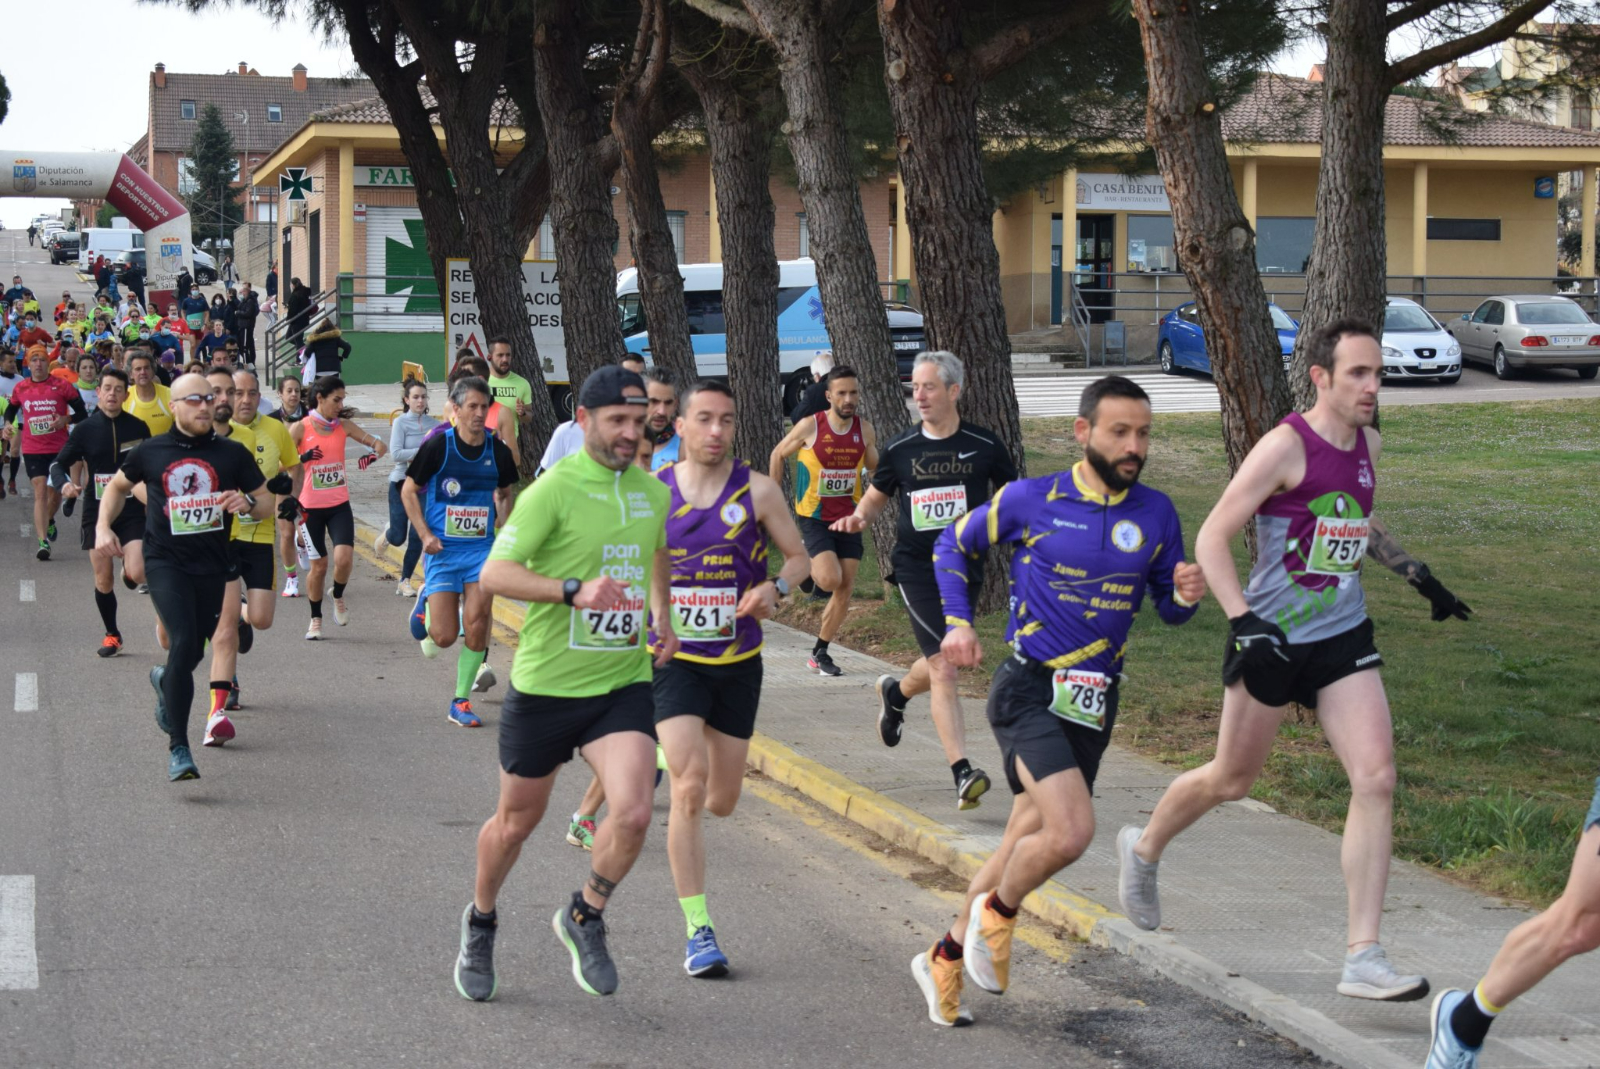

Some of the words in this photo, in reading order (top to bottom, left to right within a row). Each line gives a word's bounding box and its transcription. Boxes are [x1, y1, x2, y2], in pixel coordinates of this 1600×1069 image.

[38, 166, 84, 176] Diputación
[49, 178, 93, 187] Salamanca
[1093, 183, 1126, 194] CASA
[1128, 184, 1165, 195] BENIT
[116, 181, 160, 221] DEPORTISTAS
[120, 172, 136, 188] CON
[134, 185, 169, 217] NUESTROS
[496, 387, 516, 397] RUN
[34, 422, 50, 431] 780
[312, 462, 343, 475] bedunia
[821, 470, 857, 480] bedunia
[910, 456, 974, 477] Kaoba
[319, 471, 340, 484] 769
[826, 479, 849, 491] 801
[913, 489, 965, 506] bedunia
[181, 507, 213, 525] 797
[448, 507, 488, 519] bedunia
[922, 501, 956, 520] 707
[455, 517, 480, 530] 704
[1317, 520, 1369, 539] bedunia
[603, 543, 640, 562] pan
[1326, 538, 1361, 562] 757
[600, 559, 645, 581] cake
[589, 612, 633, 635] 748
[679, 606, 720, 628] 761
[1070, 684, 1106, 713] 789
